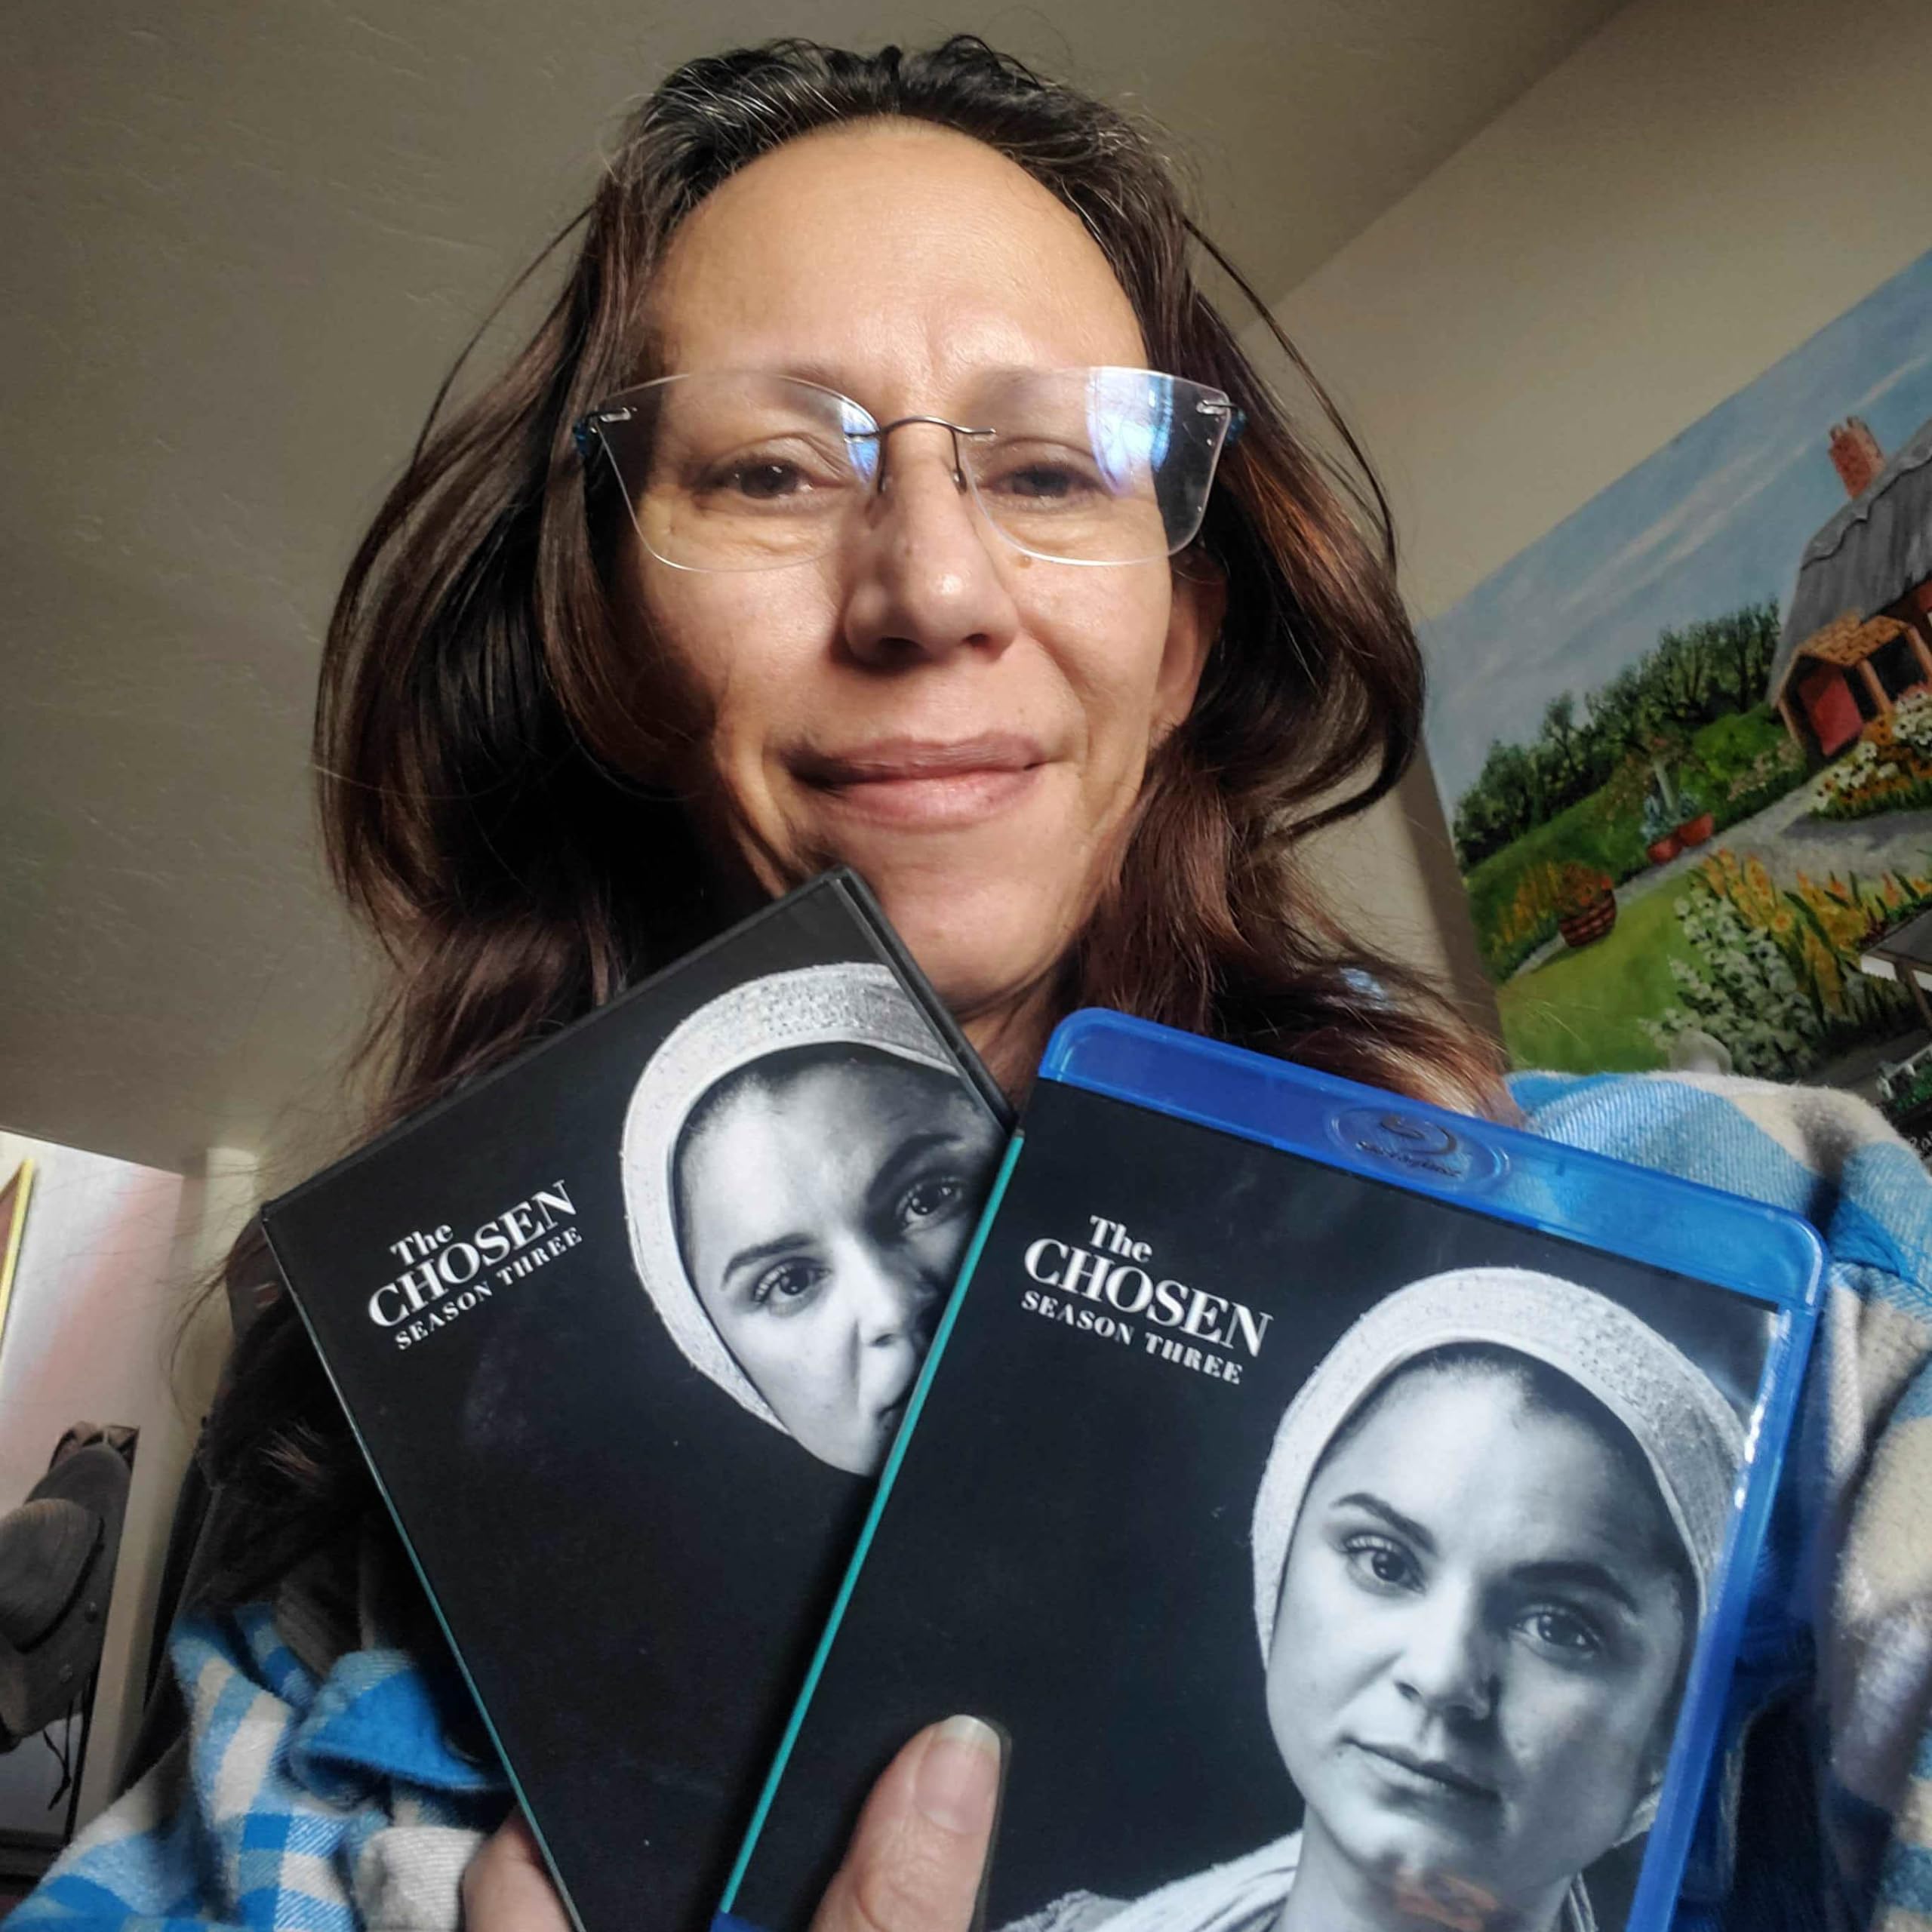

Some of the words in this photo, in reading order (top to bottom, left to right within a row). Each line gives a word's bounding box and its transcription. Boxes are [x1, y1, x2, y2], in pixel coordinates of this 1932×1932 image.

[368, 1179, 577, 1327] CHOSEN
[389, 1224, 454, 1266] The
[395, 1281, 493, 1350] SEASON
[496, 1226, 583, 1285] THREE
[1090, 1214, 1153, 1263] The
[1021, 1290, 1134, 1346] SEASON
[1145, 1332, 1243, 1385] THREE
[1024, 1238, 1274, 1357] CHOSEN
